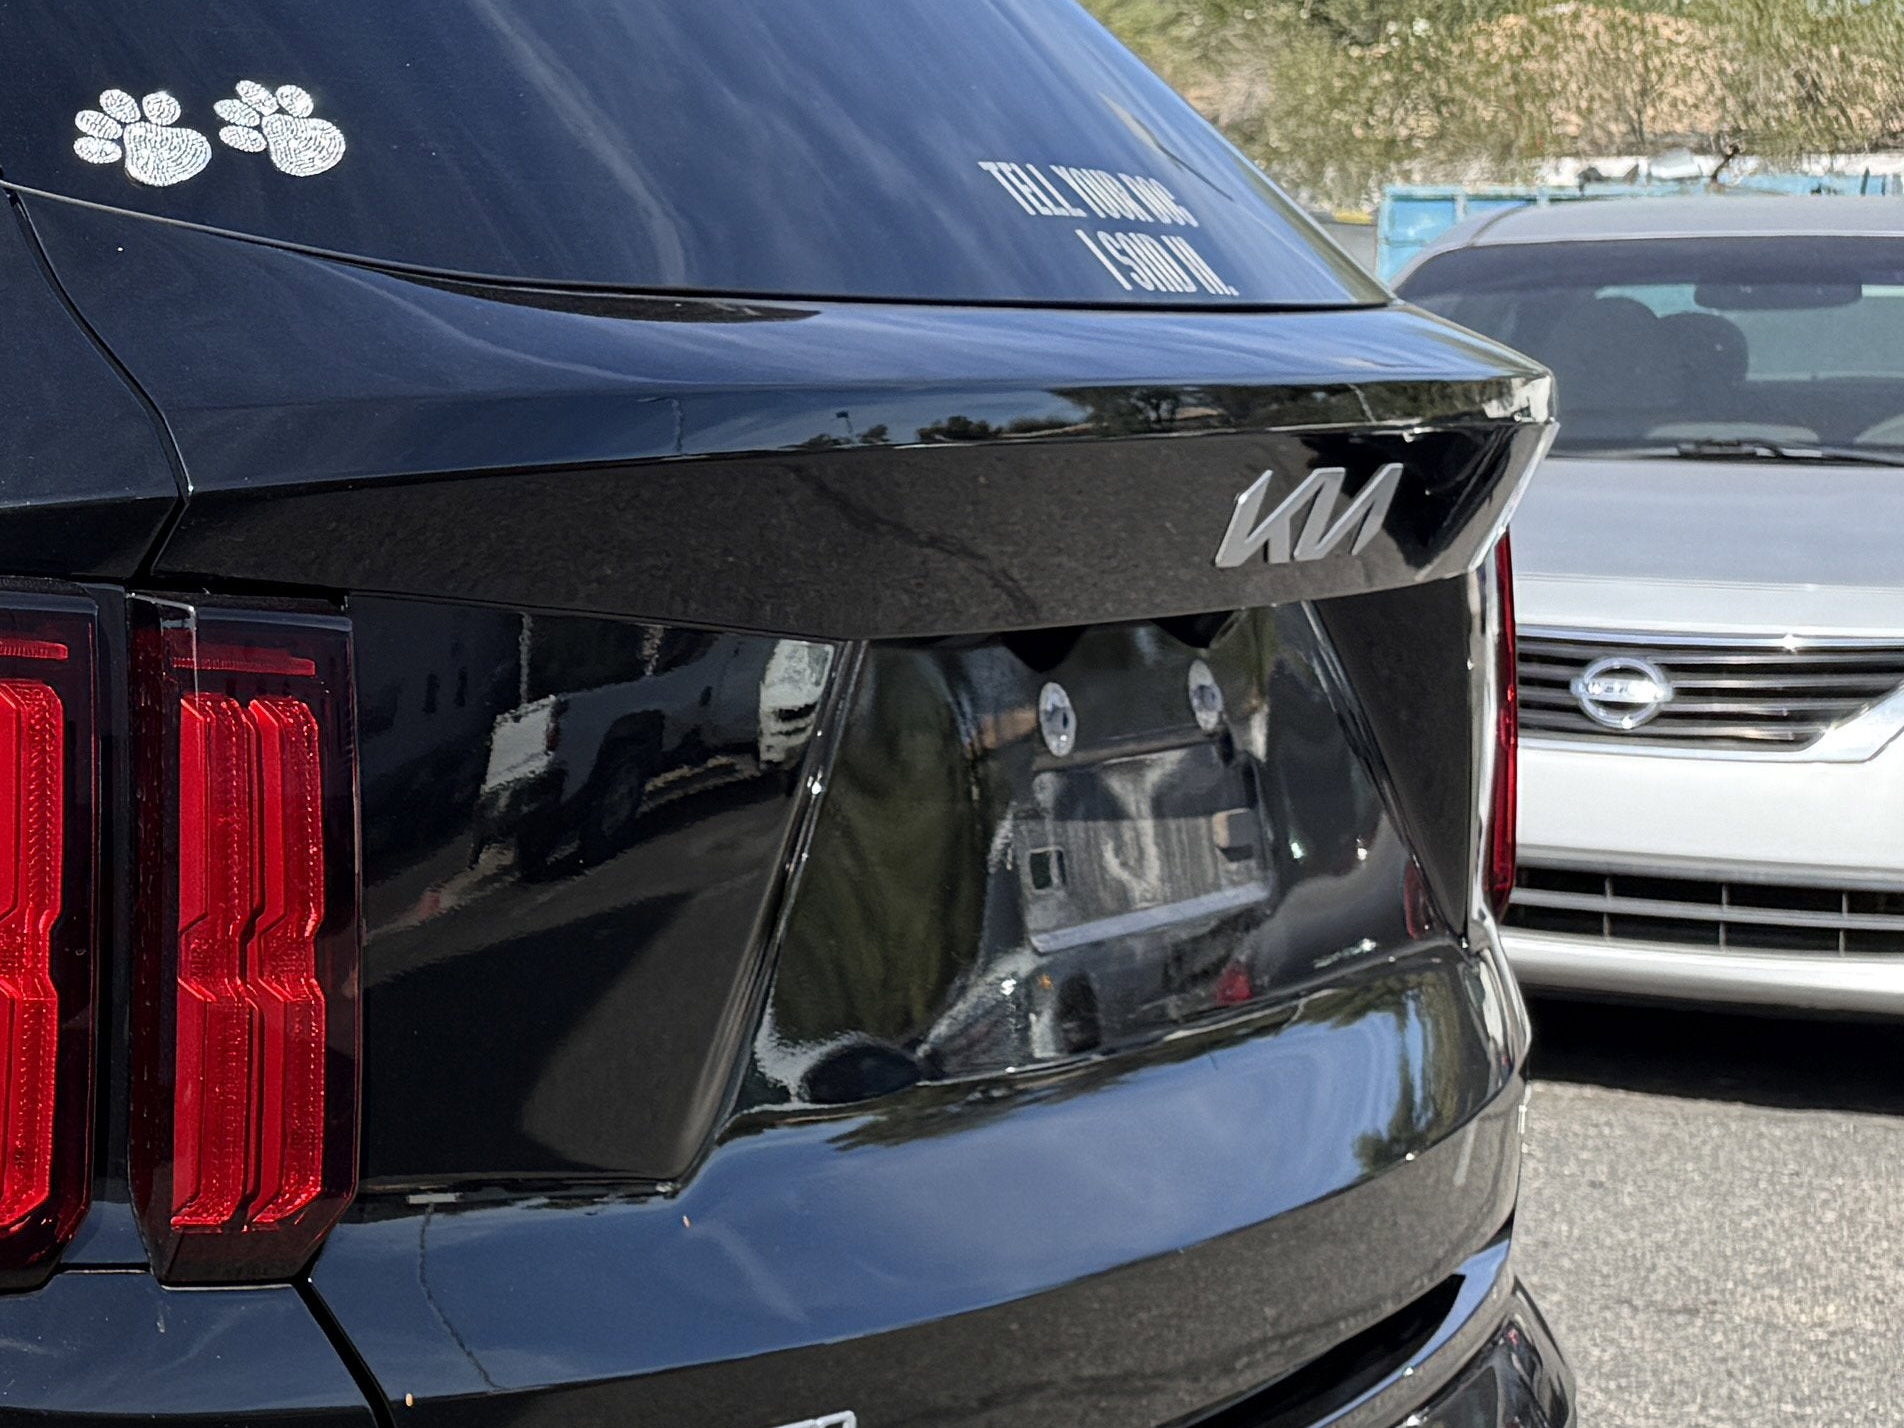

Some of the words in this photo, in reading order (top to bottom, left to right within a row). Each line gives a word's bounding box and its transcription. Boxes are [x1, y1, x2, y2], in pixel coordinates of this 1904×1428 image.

[978, 161, 1087, 217] TELL
[1049, 165, 1154, 222] YOUR
[1117, 172, 1199, 227] DOG
[1075, 228, 1133, 291] I
[1097, 230, 1197, 293] SAID
